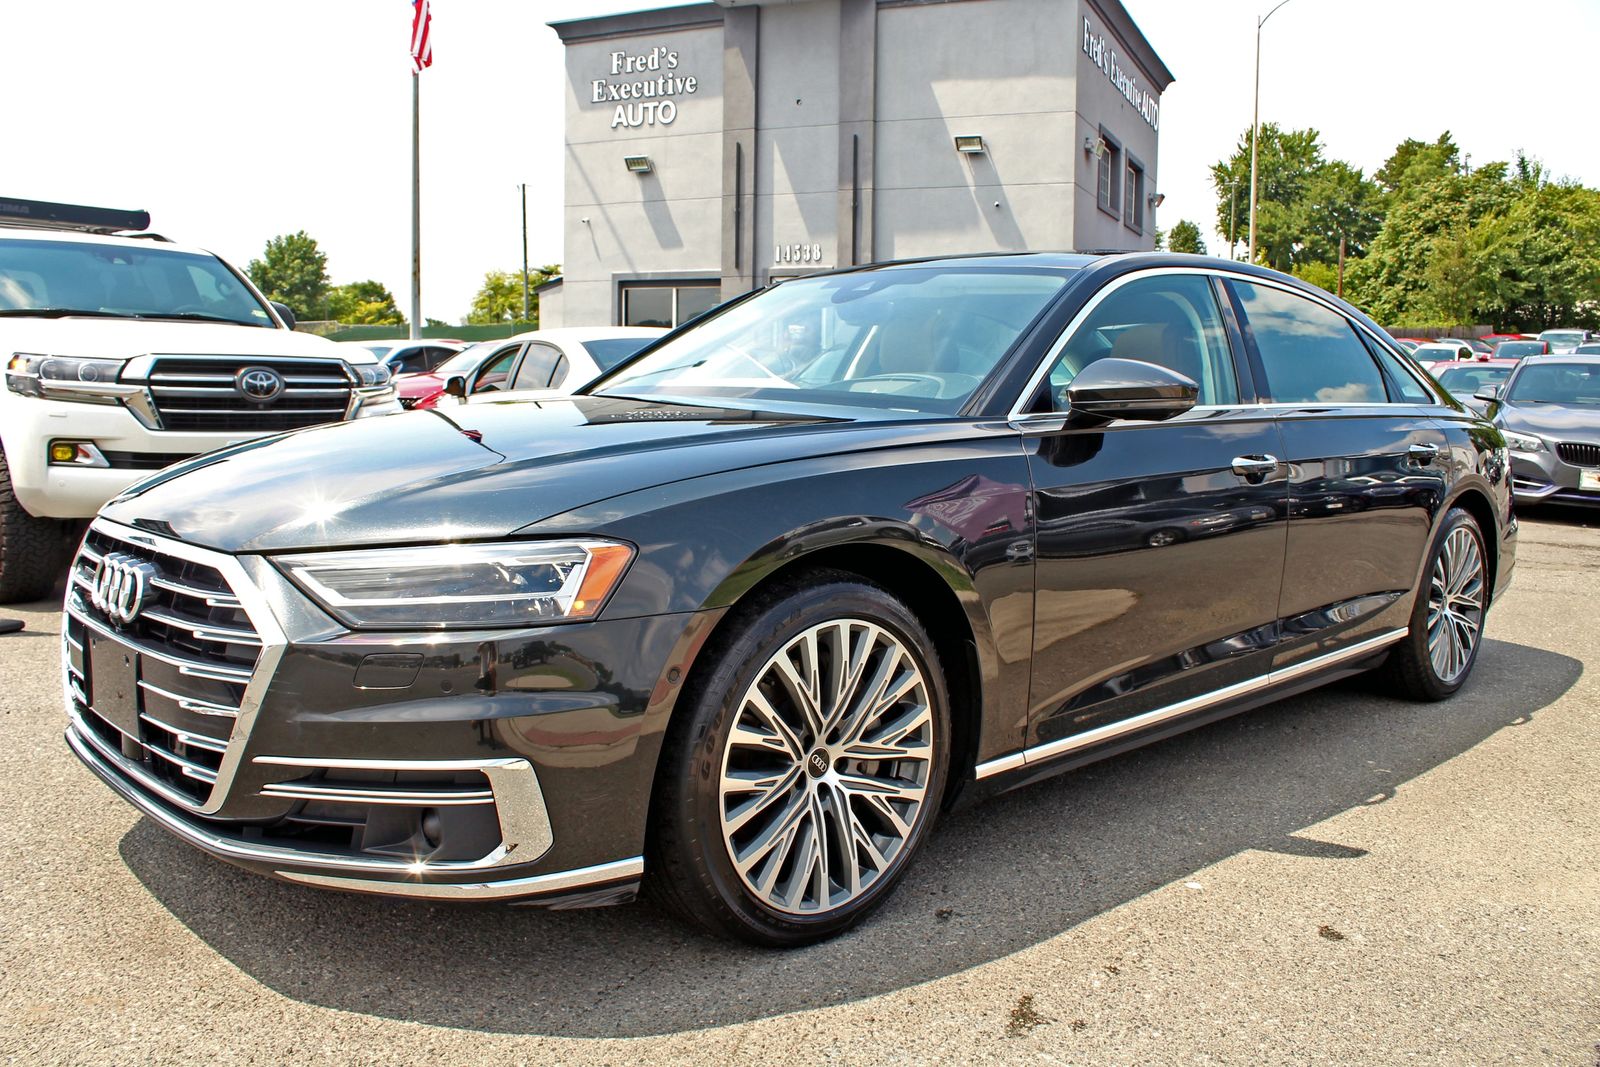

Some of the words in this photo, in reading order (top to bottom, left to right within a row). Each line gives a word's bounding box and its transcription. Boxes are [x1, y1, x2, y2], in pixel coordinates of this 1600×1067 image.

[610, 46, 678, 75] Fred's
[1083, 17, 1108, 75] Fred's
[1110, 50, 1141, 112] Executive
[1141, 90, 1159, 131] AUTO
[591, 73, 698, 103] Executive
[611, 100, 677, 128] AUTO
[774, 243, 822, 263] 14538
